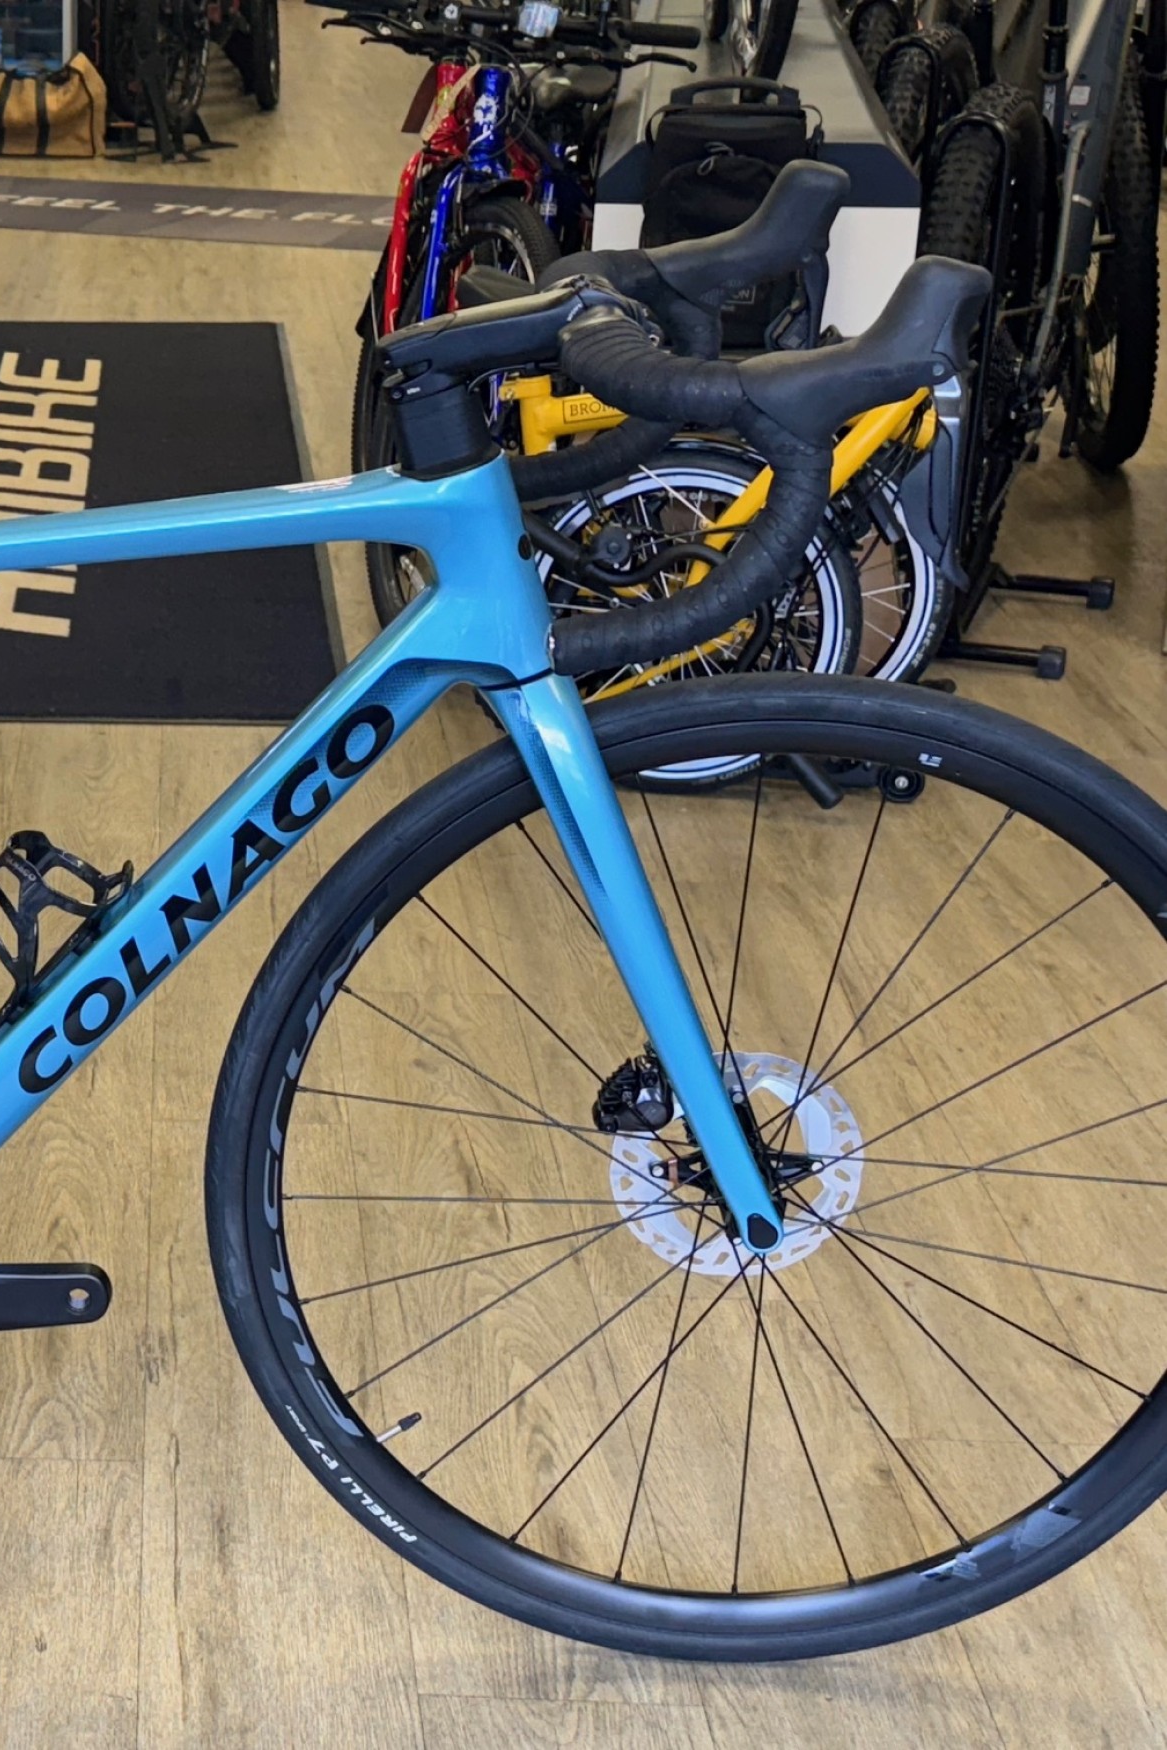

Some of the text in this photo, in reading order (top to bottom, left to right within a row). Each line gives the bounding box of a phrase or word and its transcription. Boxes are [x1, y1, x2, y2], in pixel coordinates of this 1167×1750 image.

[151, 203, 276, 220] THE
[18, 704, 395, 1094] COLNAGO
[307, 1436, 340, 1470] P7
[340, 1477, 418, 1543] PIRELLI
